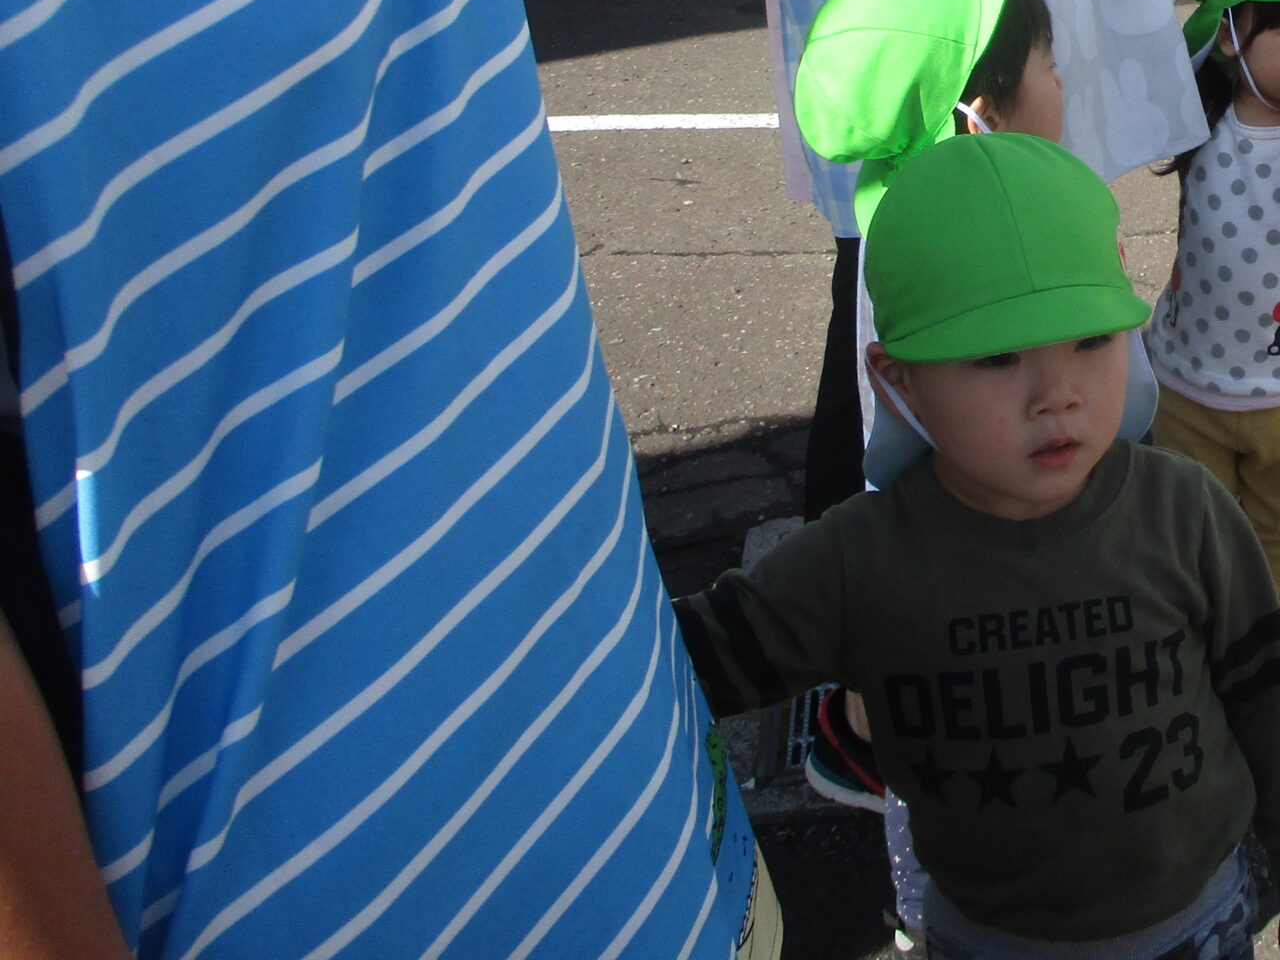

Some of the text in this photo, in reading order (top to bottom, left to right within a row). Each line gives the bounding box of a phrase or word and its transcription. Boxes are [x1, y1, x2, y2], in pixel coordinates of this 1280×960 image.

[949, 594, 1133, 656] CREATED
[884, 628, 1186, 741] DELIGHT
[1119, 711, 1204, 814] 23
